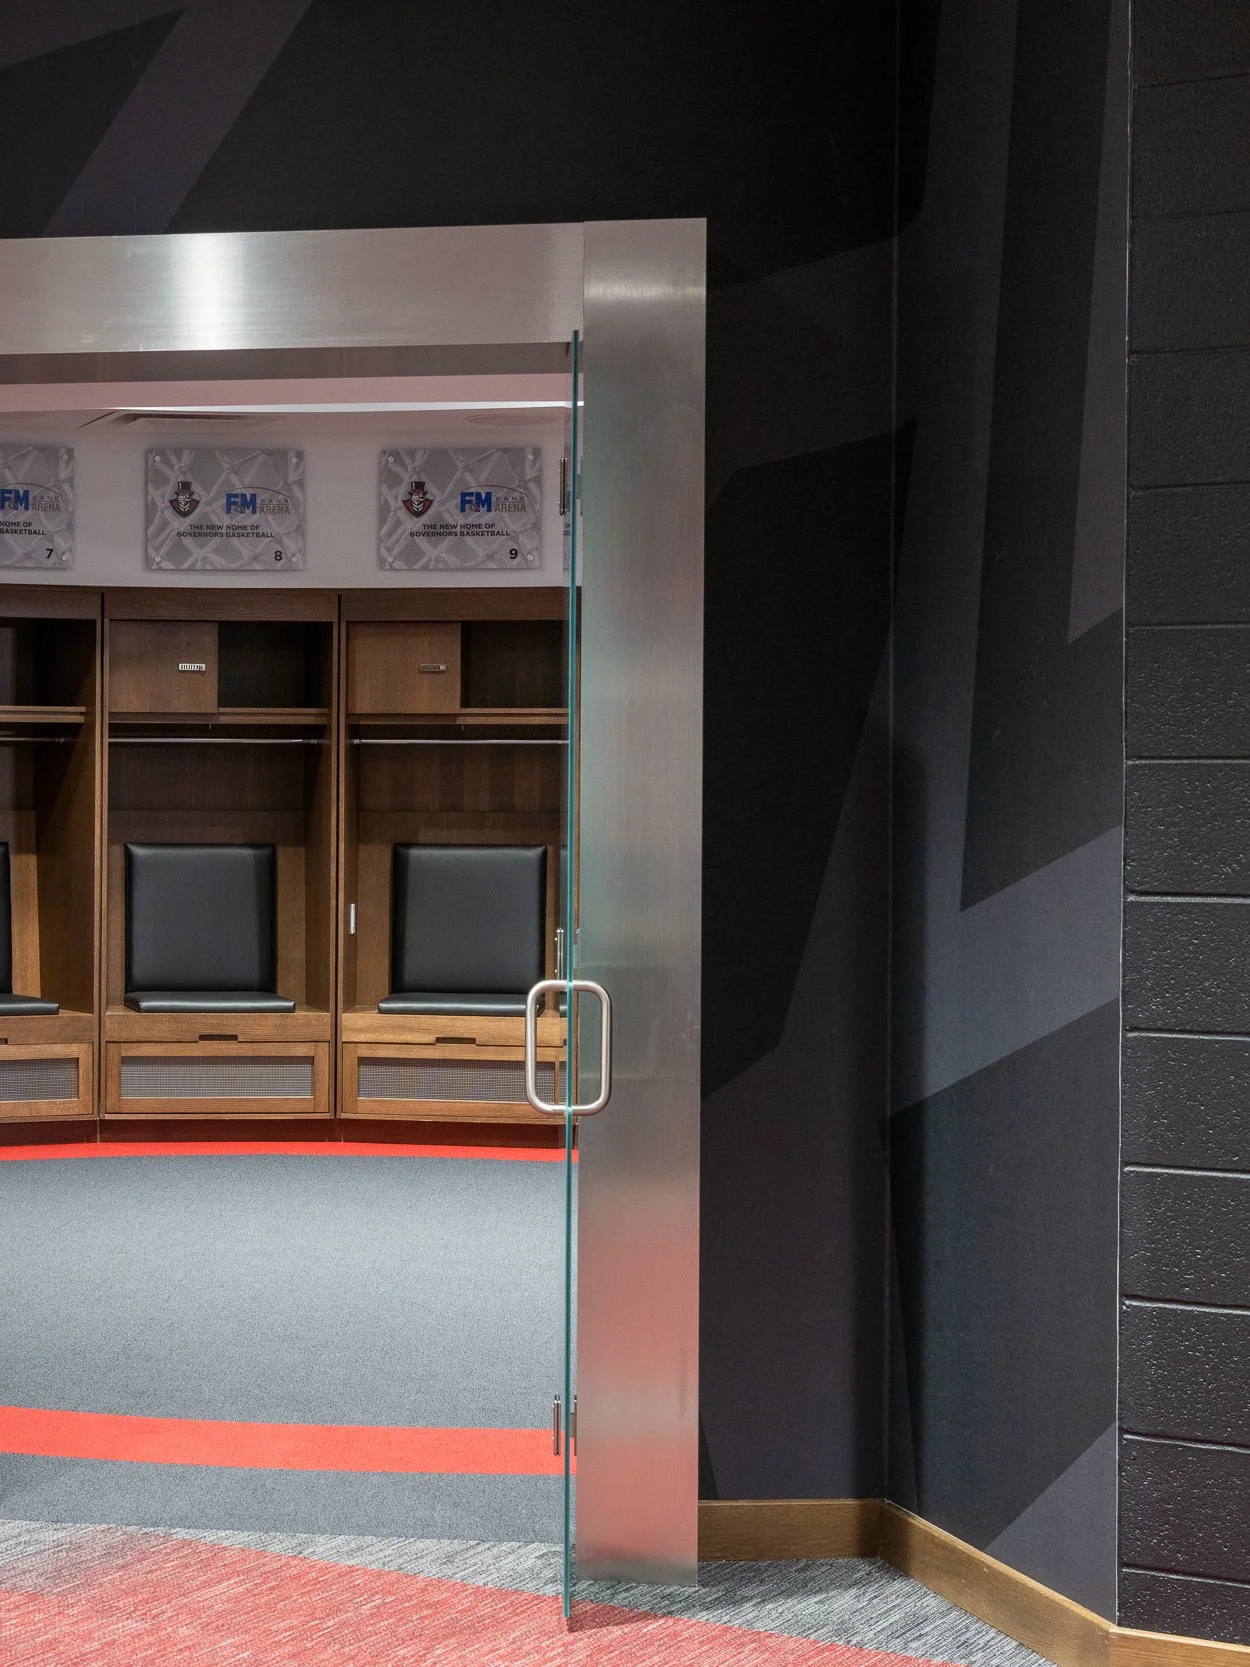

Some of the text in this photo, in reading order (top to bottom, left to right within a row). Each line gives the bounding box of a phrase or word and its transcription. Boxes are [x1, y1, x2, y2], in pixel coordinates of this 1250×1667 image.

[31, 501, 61, 512] ARENA
[259, 505, 290, 515] ARENA
[494, 503, 527, 513] ARENA
[0, 528, 47, 536] BASKETBALL
[409, 530, 458, 538] GOVERNORS
[45, 548, 54, 559] 7
[273, 550, 283, 561] 8
[509, 548, 518, 559] 9
